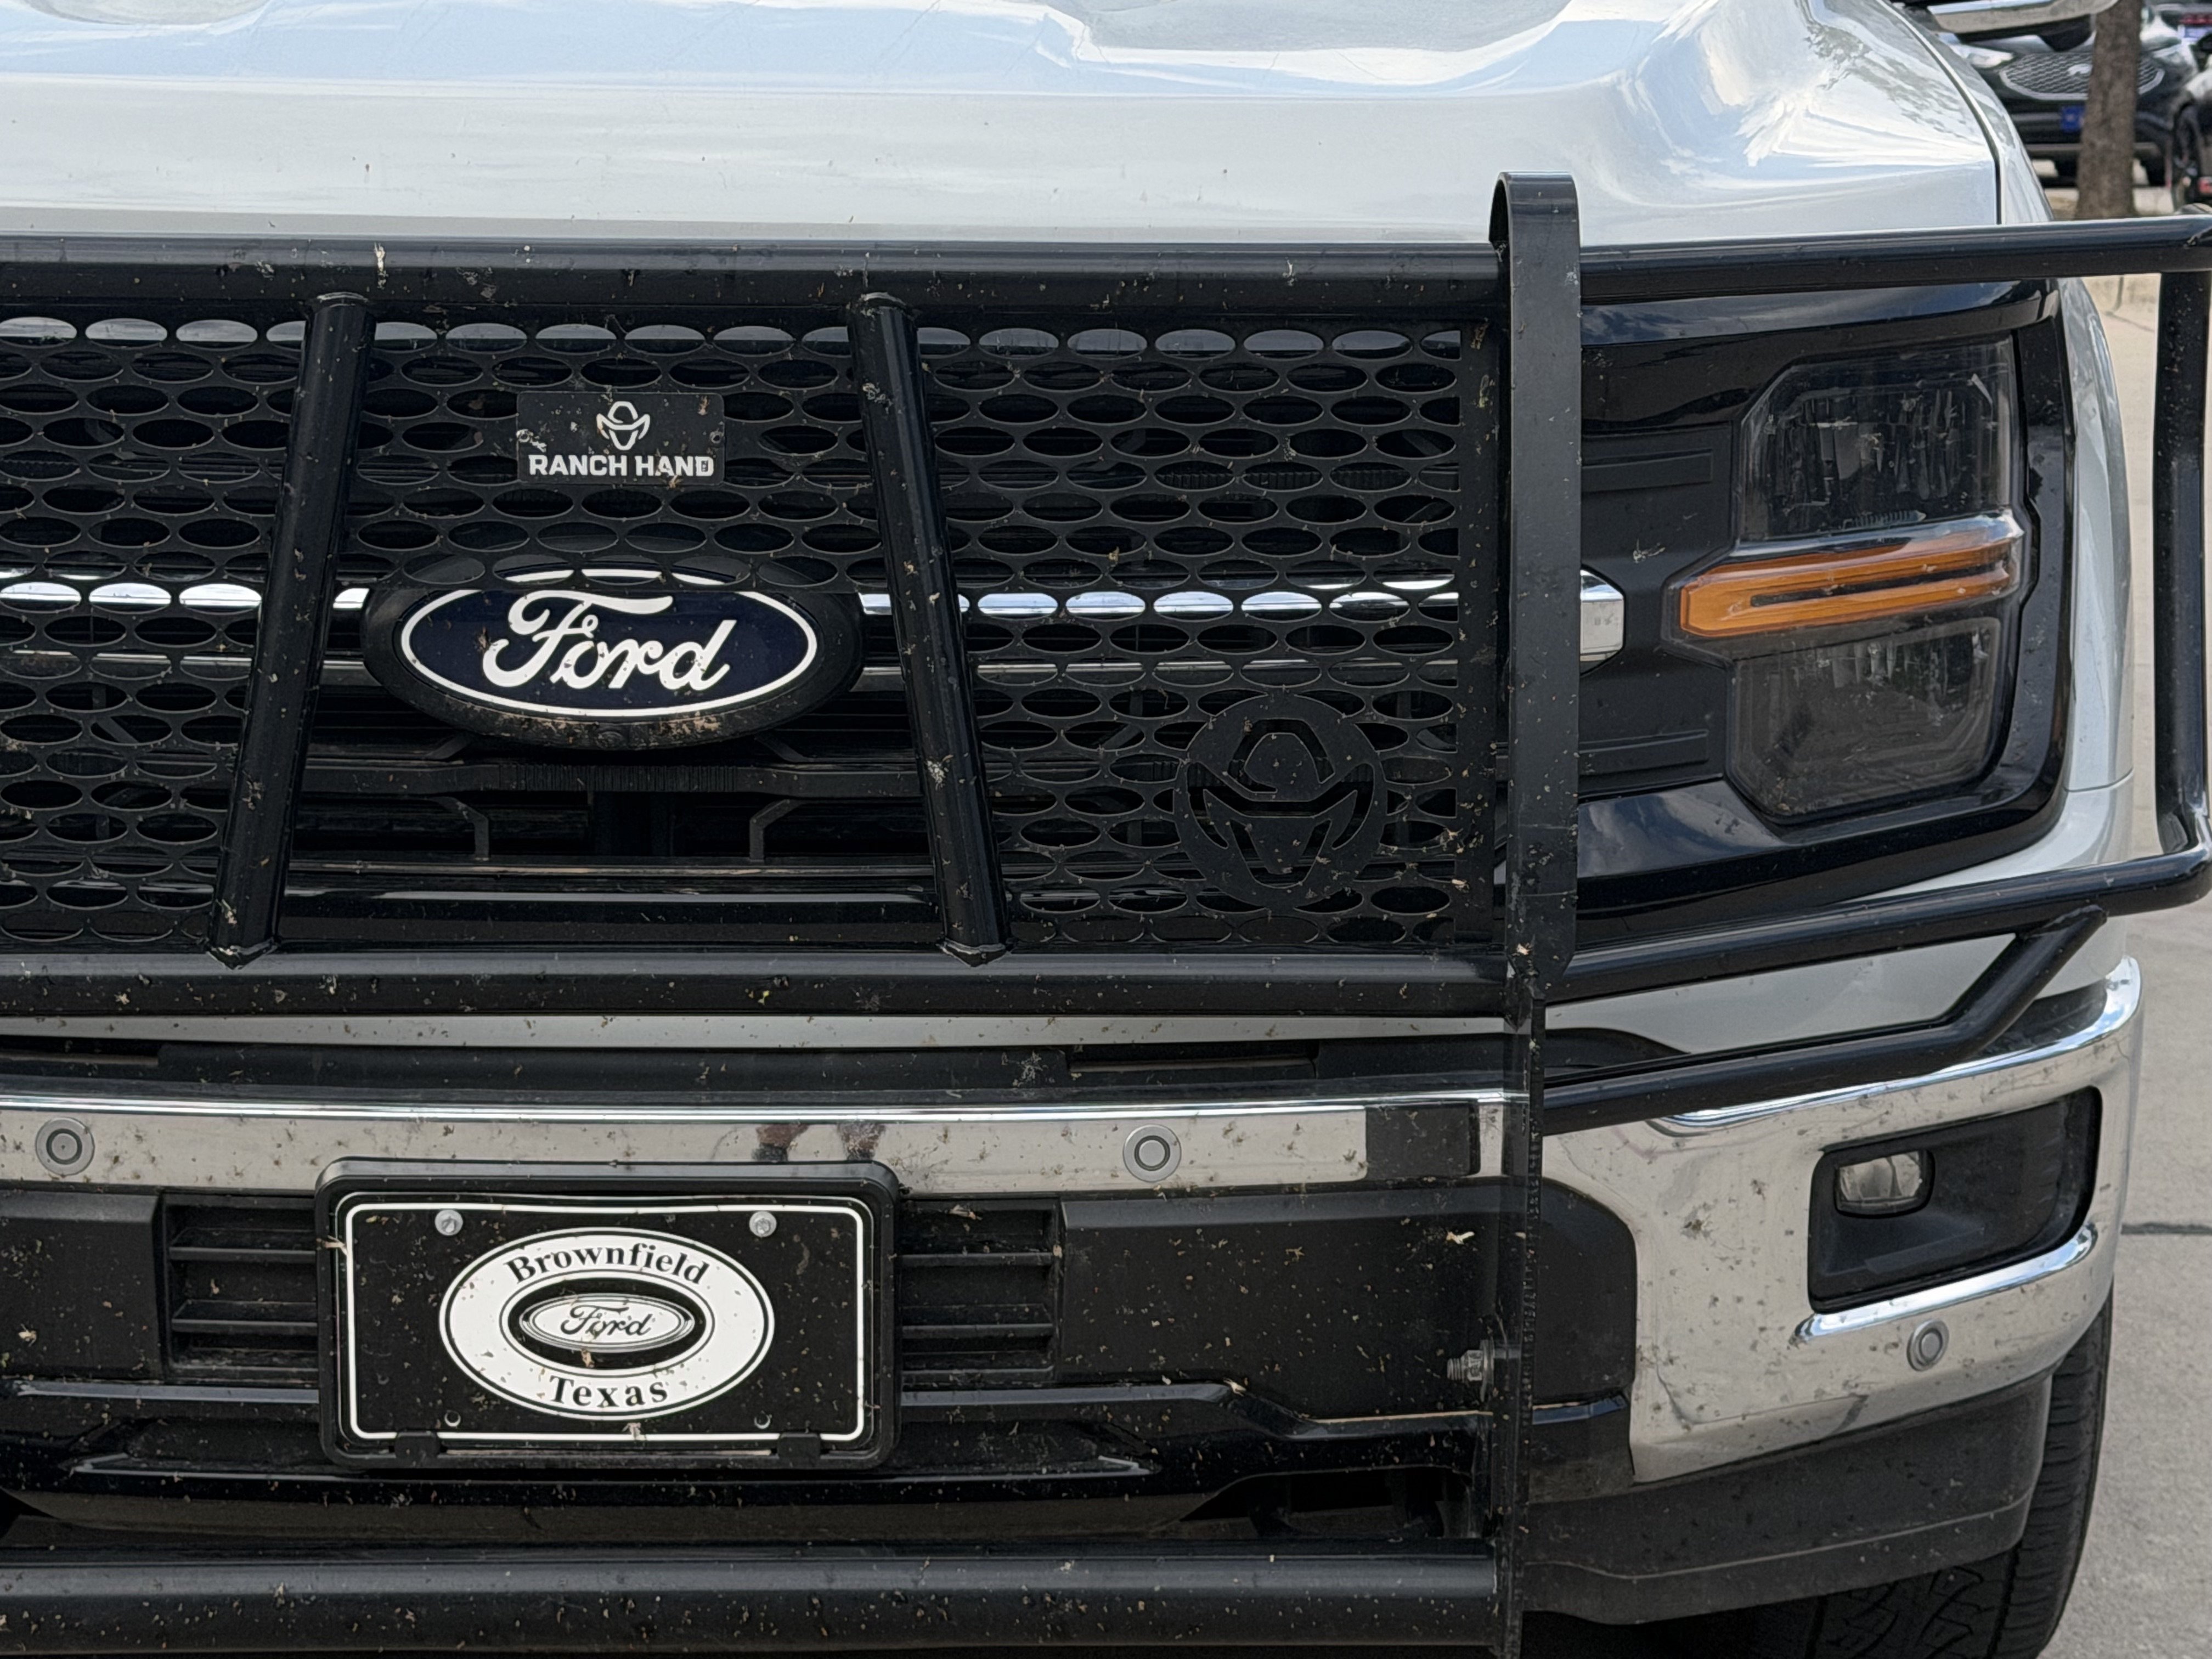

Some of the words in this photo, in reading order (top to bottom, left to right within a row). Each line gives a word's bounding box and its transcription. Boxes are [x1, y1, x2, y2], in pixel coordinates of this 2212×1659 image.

[528, 454, 628, 476] RANCH
[635, 455, 714, 476] HAND
[482, 590, 737, 691] Ford
[503, 1243, 710, 1284] Brownfield
[561, 1305, 653, 1335] Ford
[549, 1375, 668, 1408] Texas
